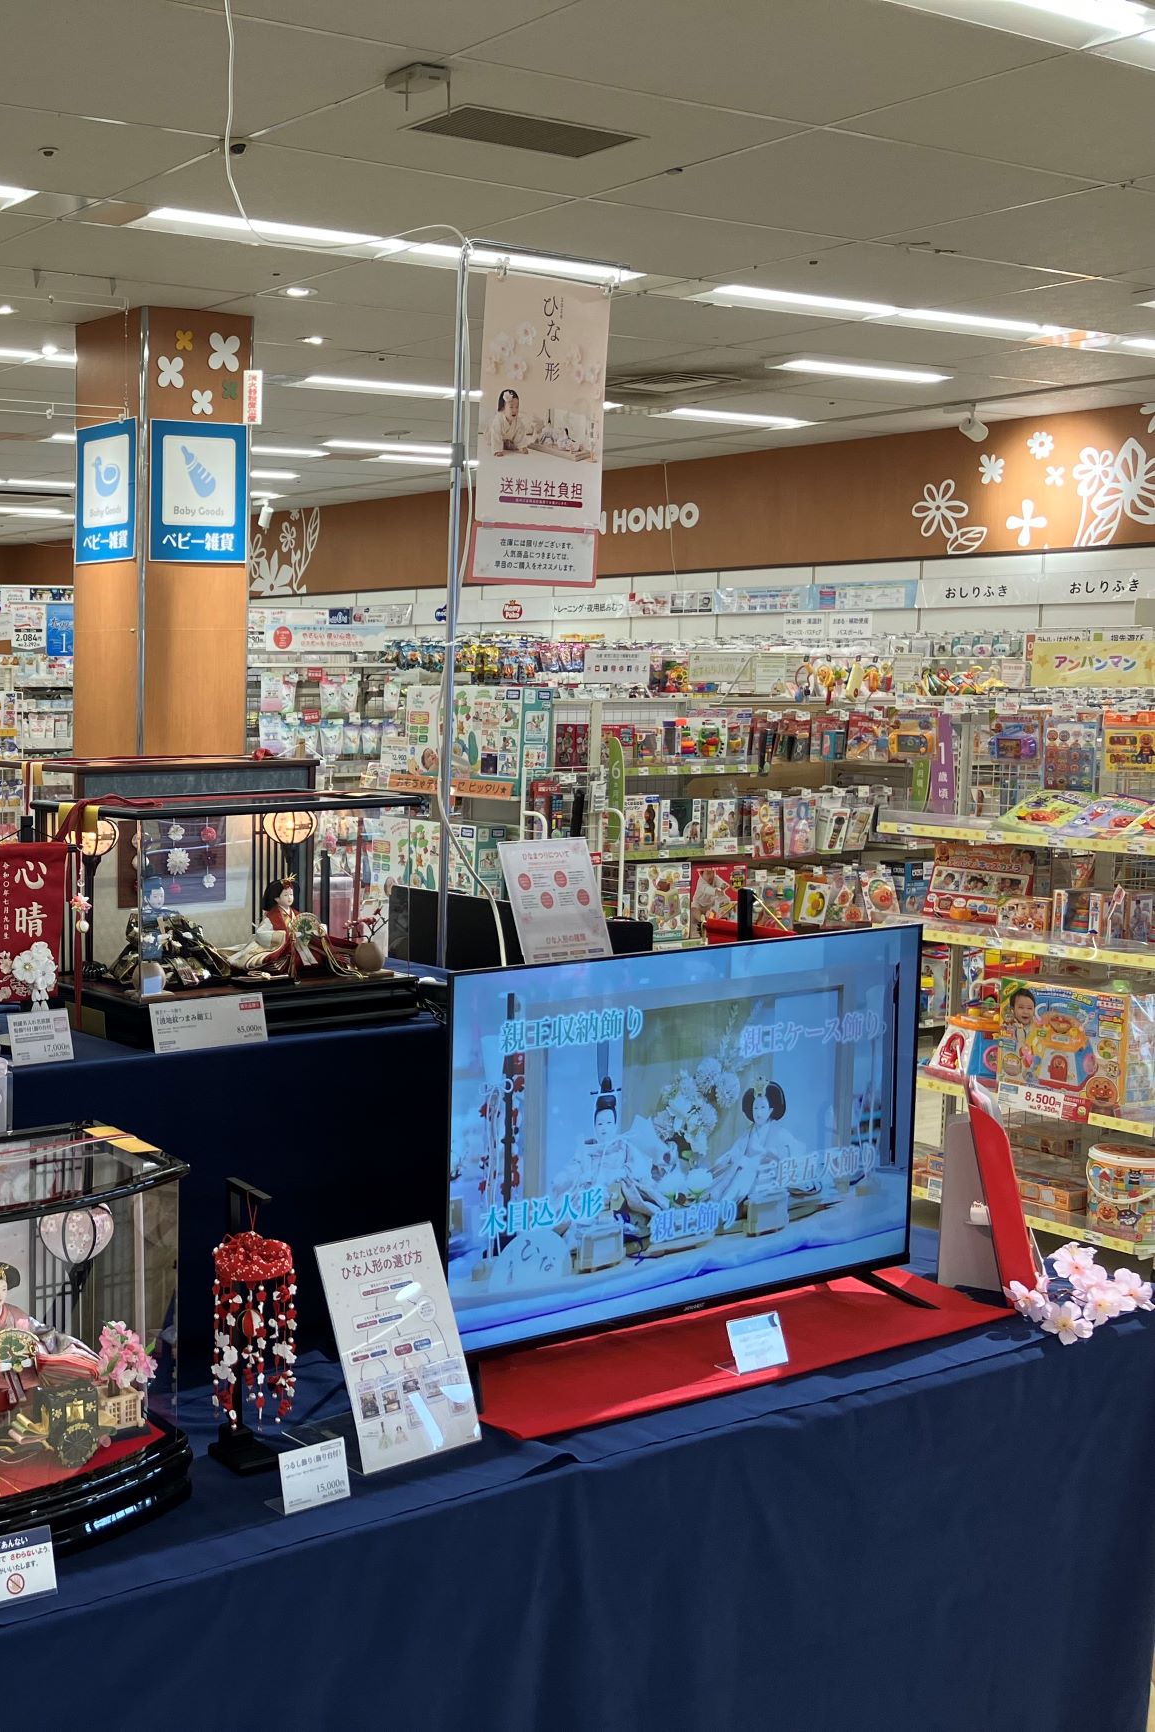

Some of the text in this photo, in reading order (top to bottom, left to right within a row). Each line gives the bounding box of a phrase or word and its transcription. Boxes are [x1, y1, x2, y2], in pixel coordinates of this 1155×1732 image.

[536, 295, 561, 382] ひな人形
[499, 477, 584, 500] 送料当社負担
[90, 505, 122, 518] Baby Goods
[173, 505, 225, 517] Baby Goods
[612, 502, 700, 535] HONPO
[83, 530, 128, 550] ベビー雑貨
[162, 532, 235, 551] ベビー雑貨
[945, 584, 1009, 599] おしりふき
[1069, 578, 1140, 595] おしりふき
[1054, 655, 1138, 672] アンパンマン
[14, 859, 48, 938] 心晴
[500, 1006, 643, 1056] 親王収納飾り
[741, 1010, 884, 1057] 親王ケース飾り
[1024, 1090, 1062, 1109] 8,500円
[480, 1188, 604, 1238] 木目込人形
[651, 1199, 738, 1242] 親王飾り
[341, 1250, 423, 1280] ひな人形の選び方
